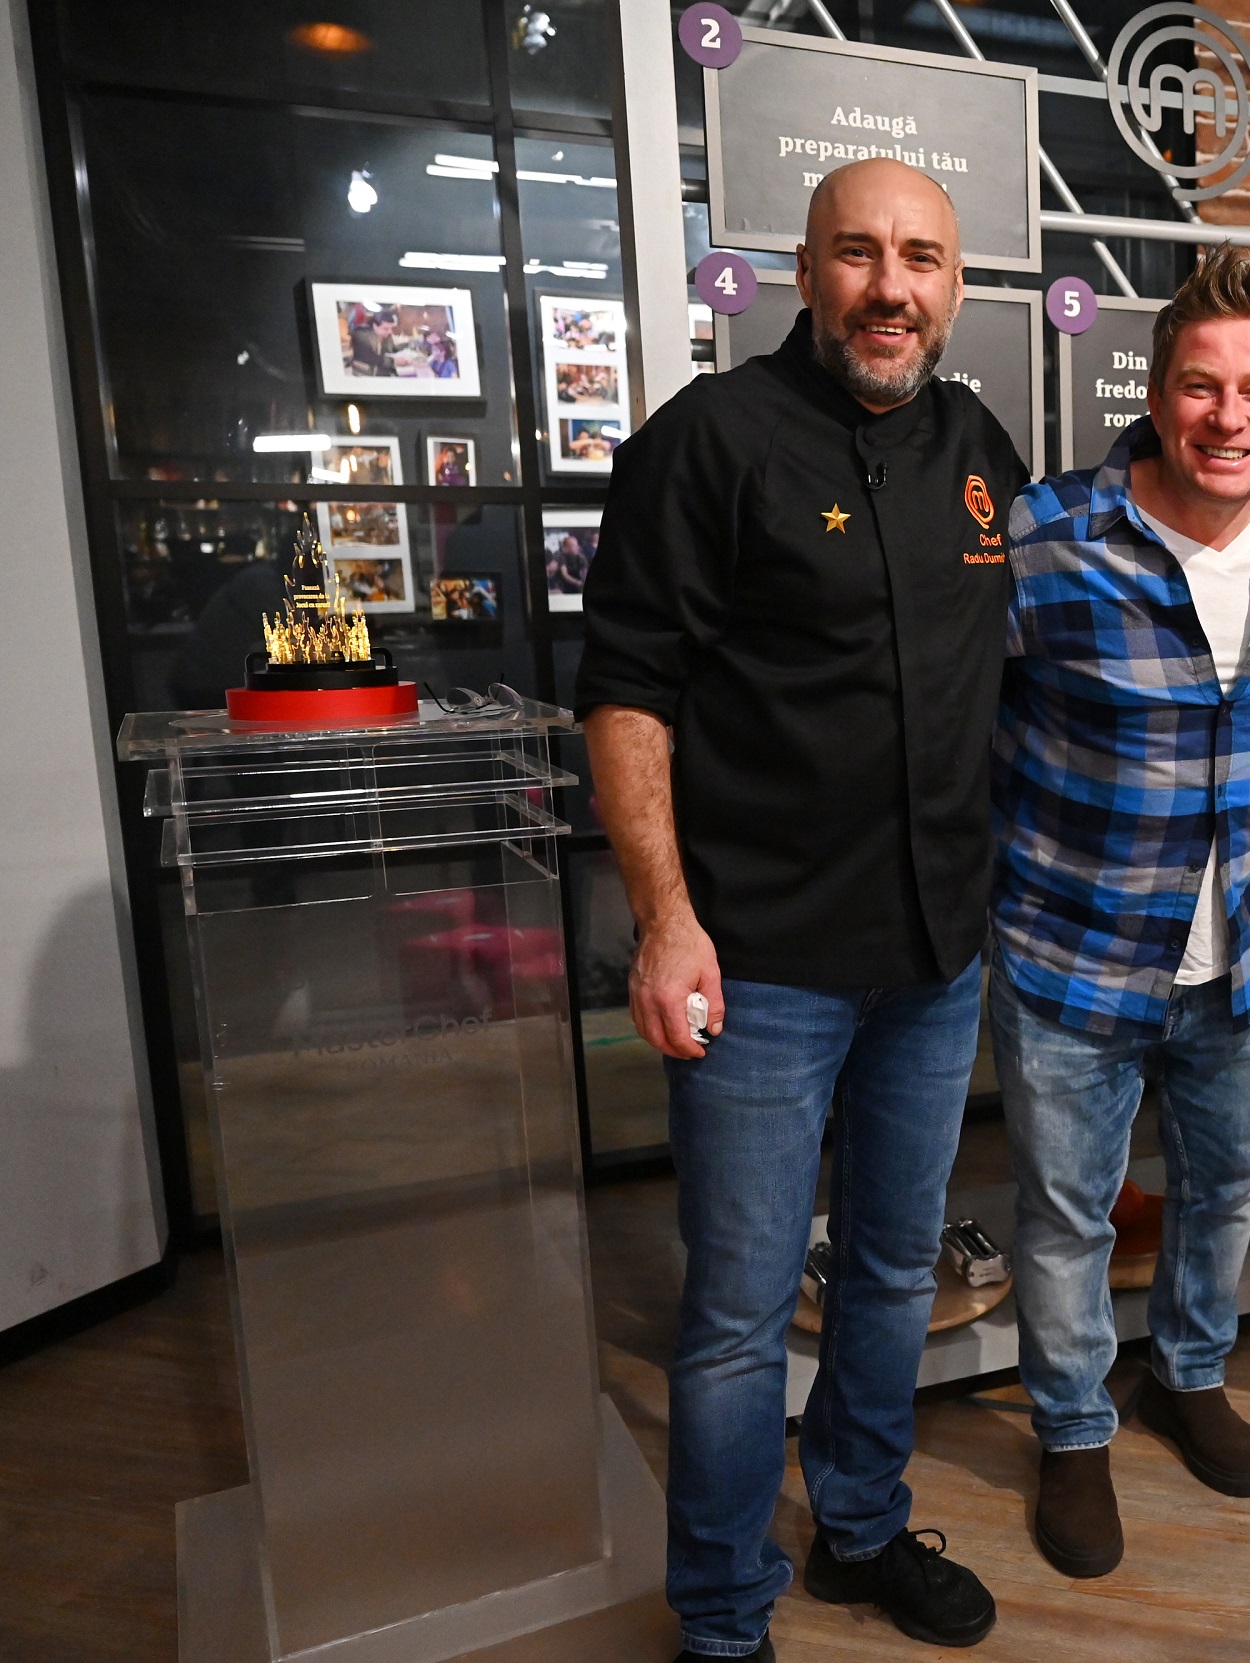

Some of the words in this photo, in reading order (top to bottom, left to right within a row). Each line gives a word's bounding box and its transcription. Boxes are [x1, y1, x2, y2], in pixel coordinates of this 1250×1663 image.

[700, 18, 721, 49] 2
[830, 106, 918, 139] Adaugă
[778, 136, 926, 168] preparatului
[930, 150, 969, 173] tău
[714, 266, 738, 296] 4
[1063, 290, 1081, 318] 5
[1112, 351, 1148, 371] Din
[1095, 379, 1149, 400] fredo
[980, 533, 1002, 546] Chef
[963, 553, 983, 564] Radu
